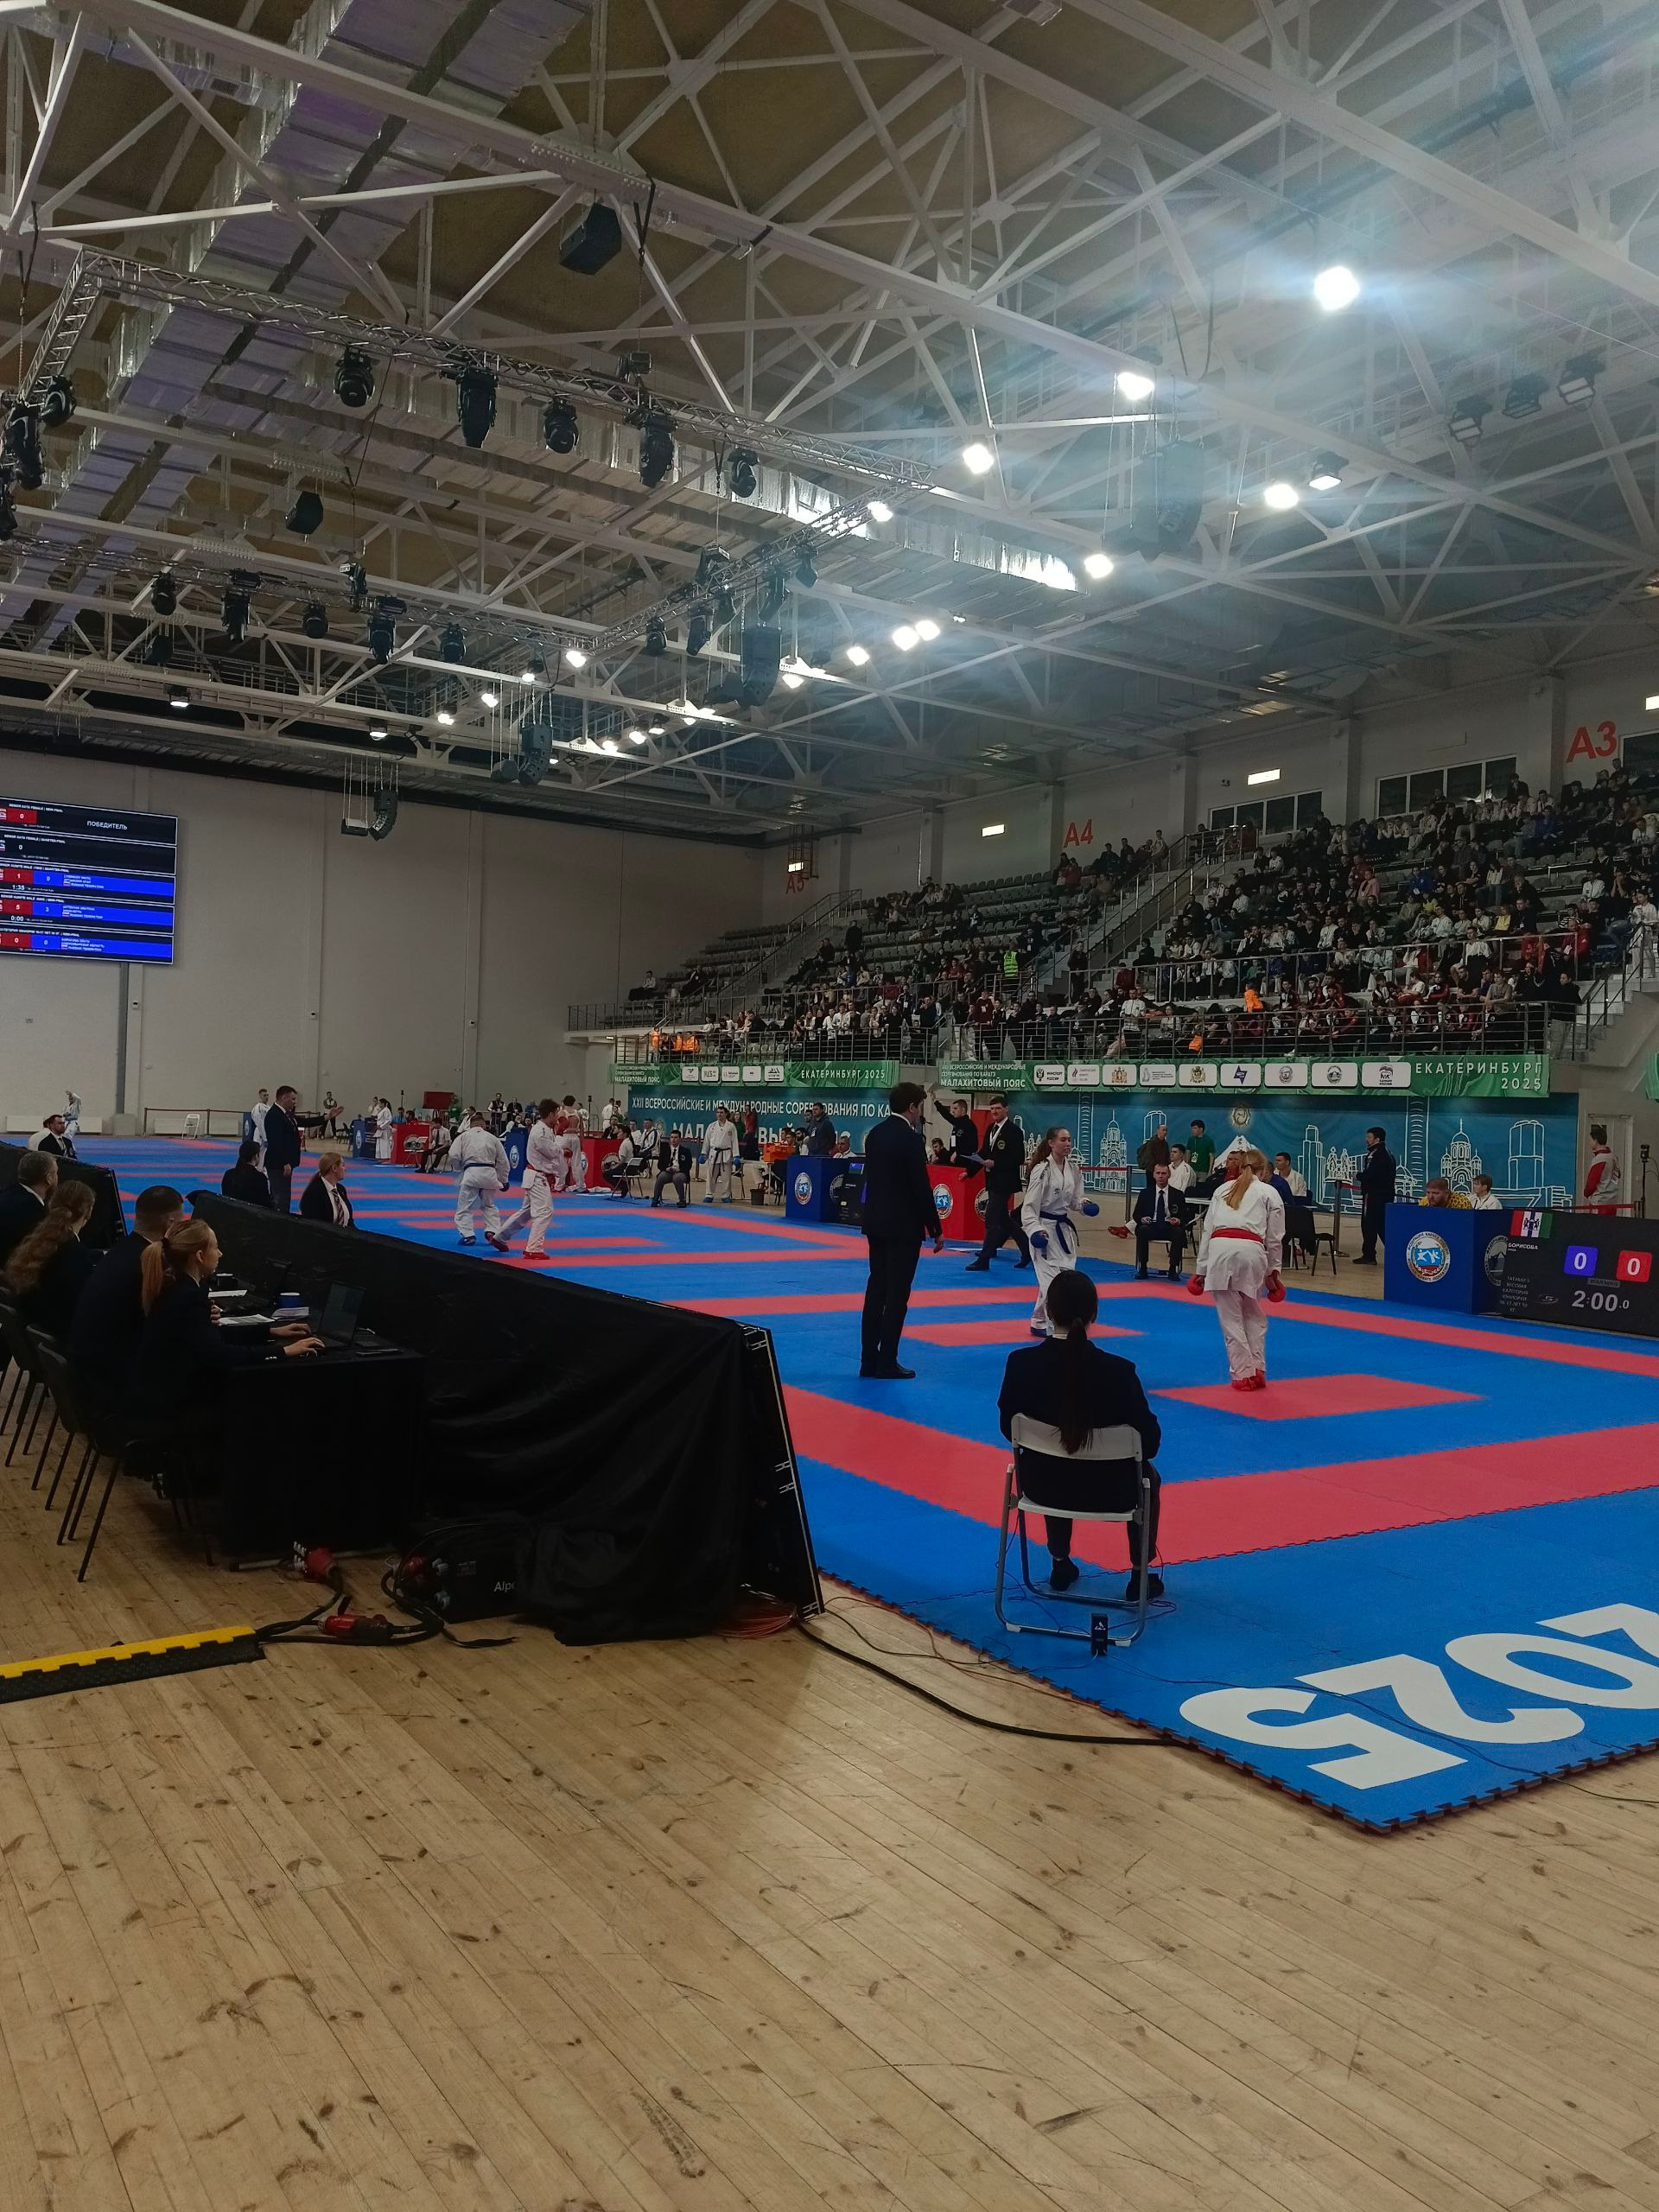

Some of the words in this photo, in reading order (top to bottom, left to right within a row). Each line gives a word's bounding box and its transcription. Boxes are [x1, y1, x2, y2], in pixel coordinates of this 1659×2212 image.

[86, 820, 128, 830] ПОБЕДИТЕЛЬ
[1415, 1062, 1541, 1074] ЕКАТЕРИНБУРГ
[801, 1070, 861, 1079] ЕКАТЕРИНБУРГ
[865, 1070, 885, 1079] 2025
[940, 1077, 1001, 1087] МАЛАХИТОВЫЙ
[1501, 1077, 1541, 1090] 2025
[645, 1096, 704, 1111] ВСЕРОССИЙСКИЕ
[705, 1099, 710, 1111] И
[785, 1102, 858, 1116] СОРЕВОВАНИЯ
[861, 1103, 875, 1117] ПО
[1574, 1252, 1587, 1270] 0
[1627, 1258, 1641, 1275] 0
